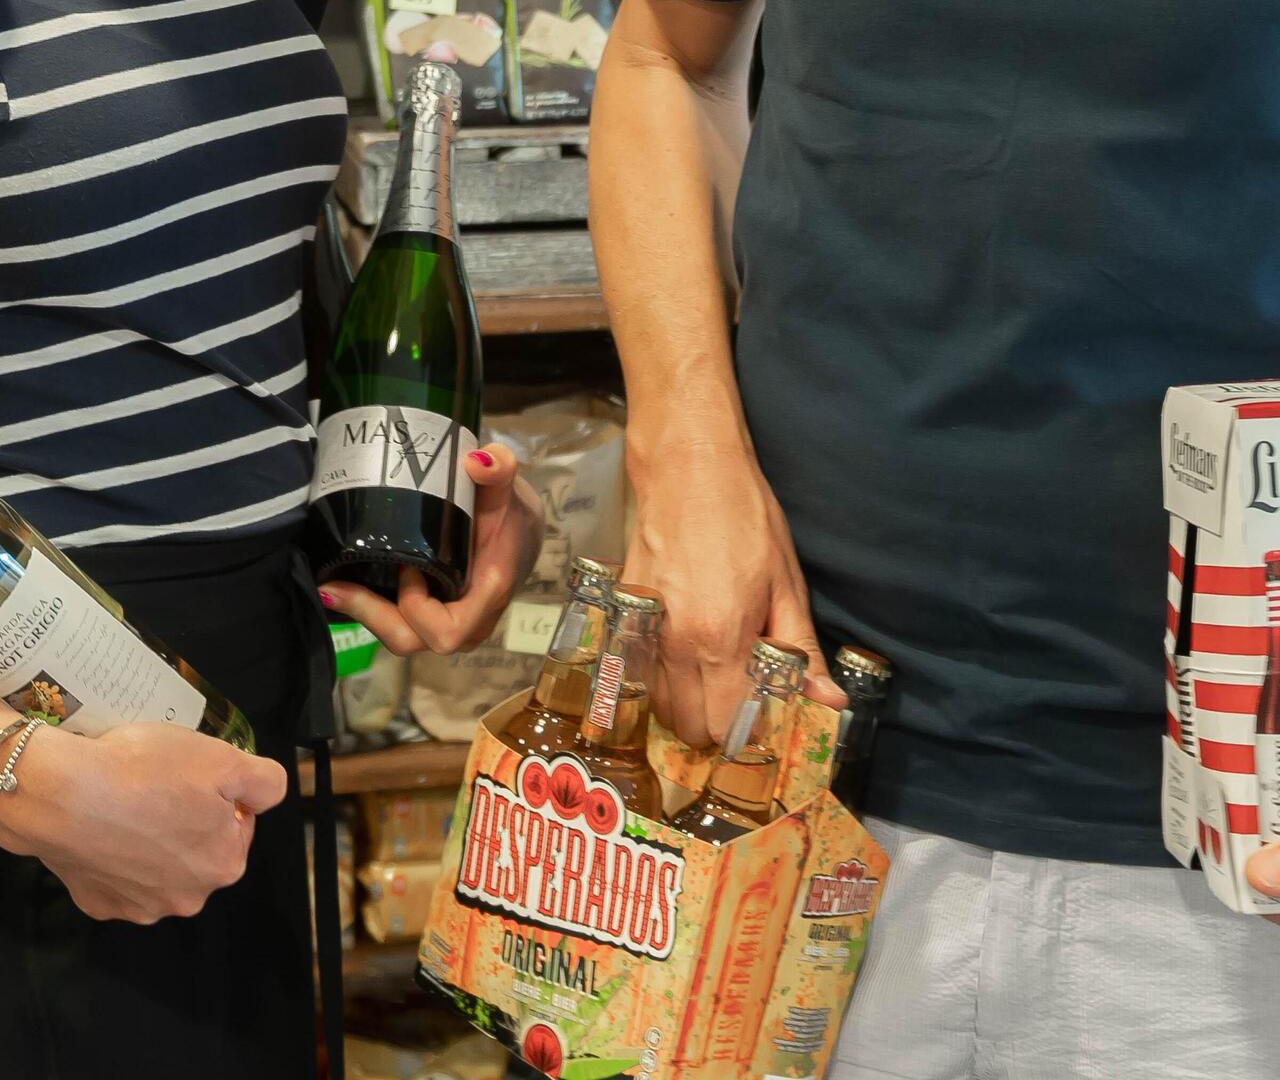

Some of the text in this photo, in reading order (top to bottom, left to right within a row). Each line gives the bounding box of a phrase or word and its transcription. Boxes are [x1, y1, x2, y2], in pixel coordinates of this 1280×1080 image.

[343, 420, 410, 447] MAS
[22, 596, 65, 650] GRIGIO
[462, 784, 678, 951] DESPERADOS
[501, 929, 600, 1000] ORIGINAL
